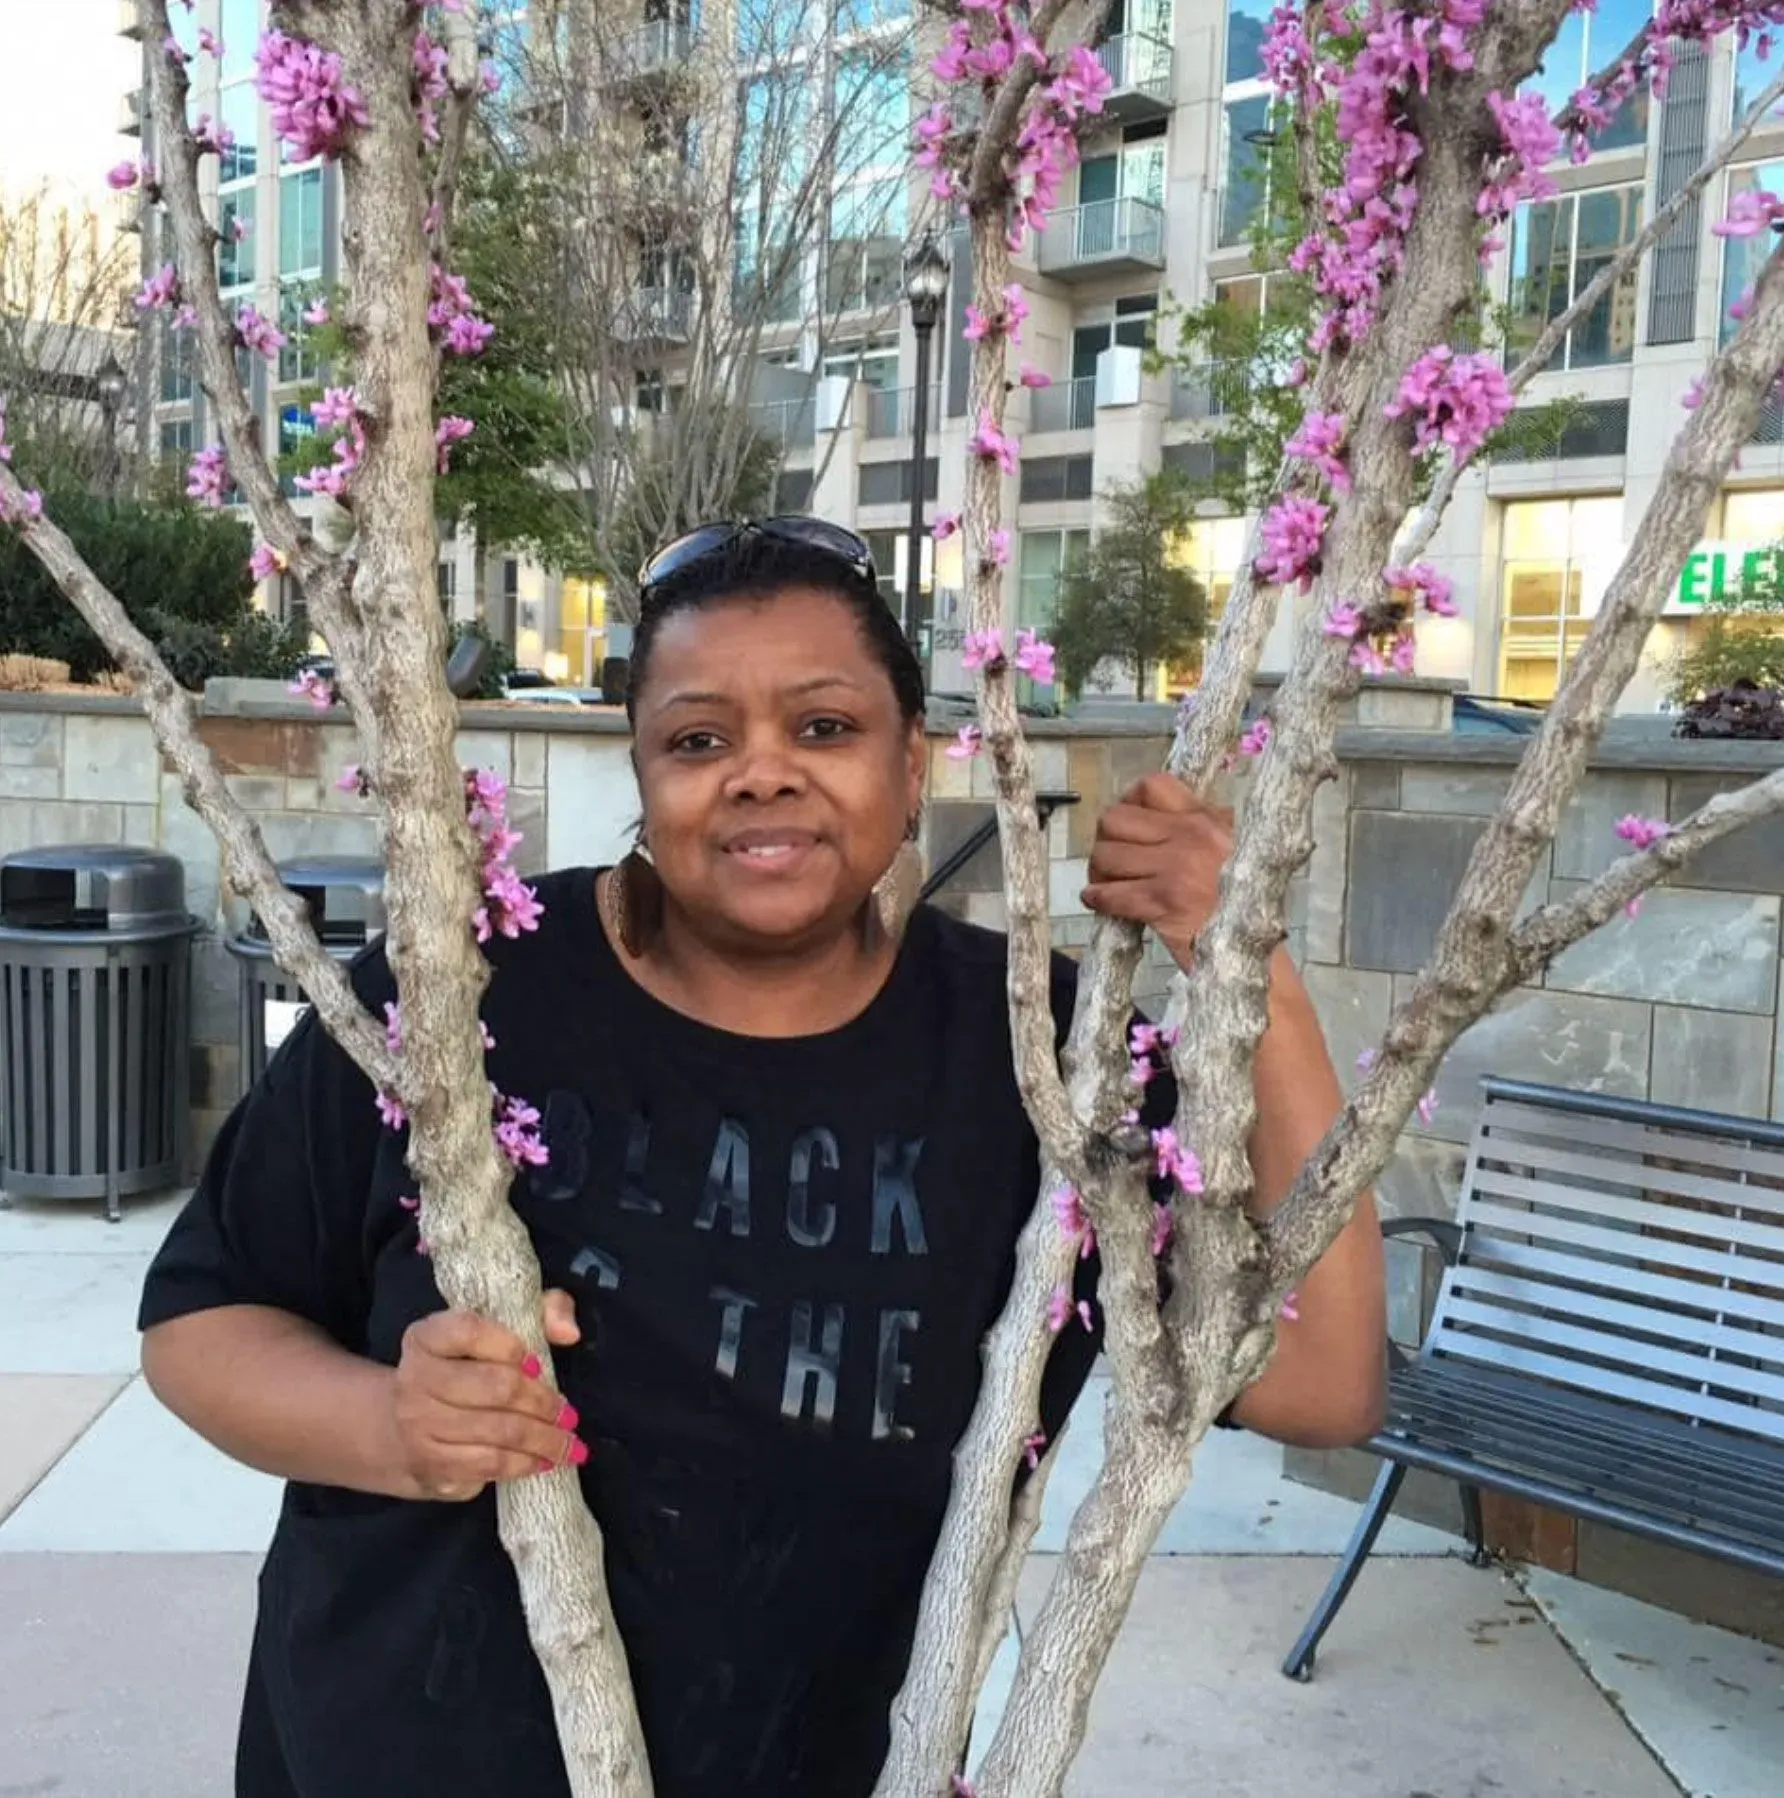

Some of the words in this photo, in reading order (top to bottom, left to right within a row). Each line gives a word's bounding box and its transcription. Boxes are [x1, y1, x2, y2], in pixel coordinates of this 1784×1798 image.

[1679, 552, 1784, 603] ELE
[526, 1089, 929, 1256] BLACK
[708, 1286, 921, 1441] THE
